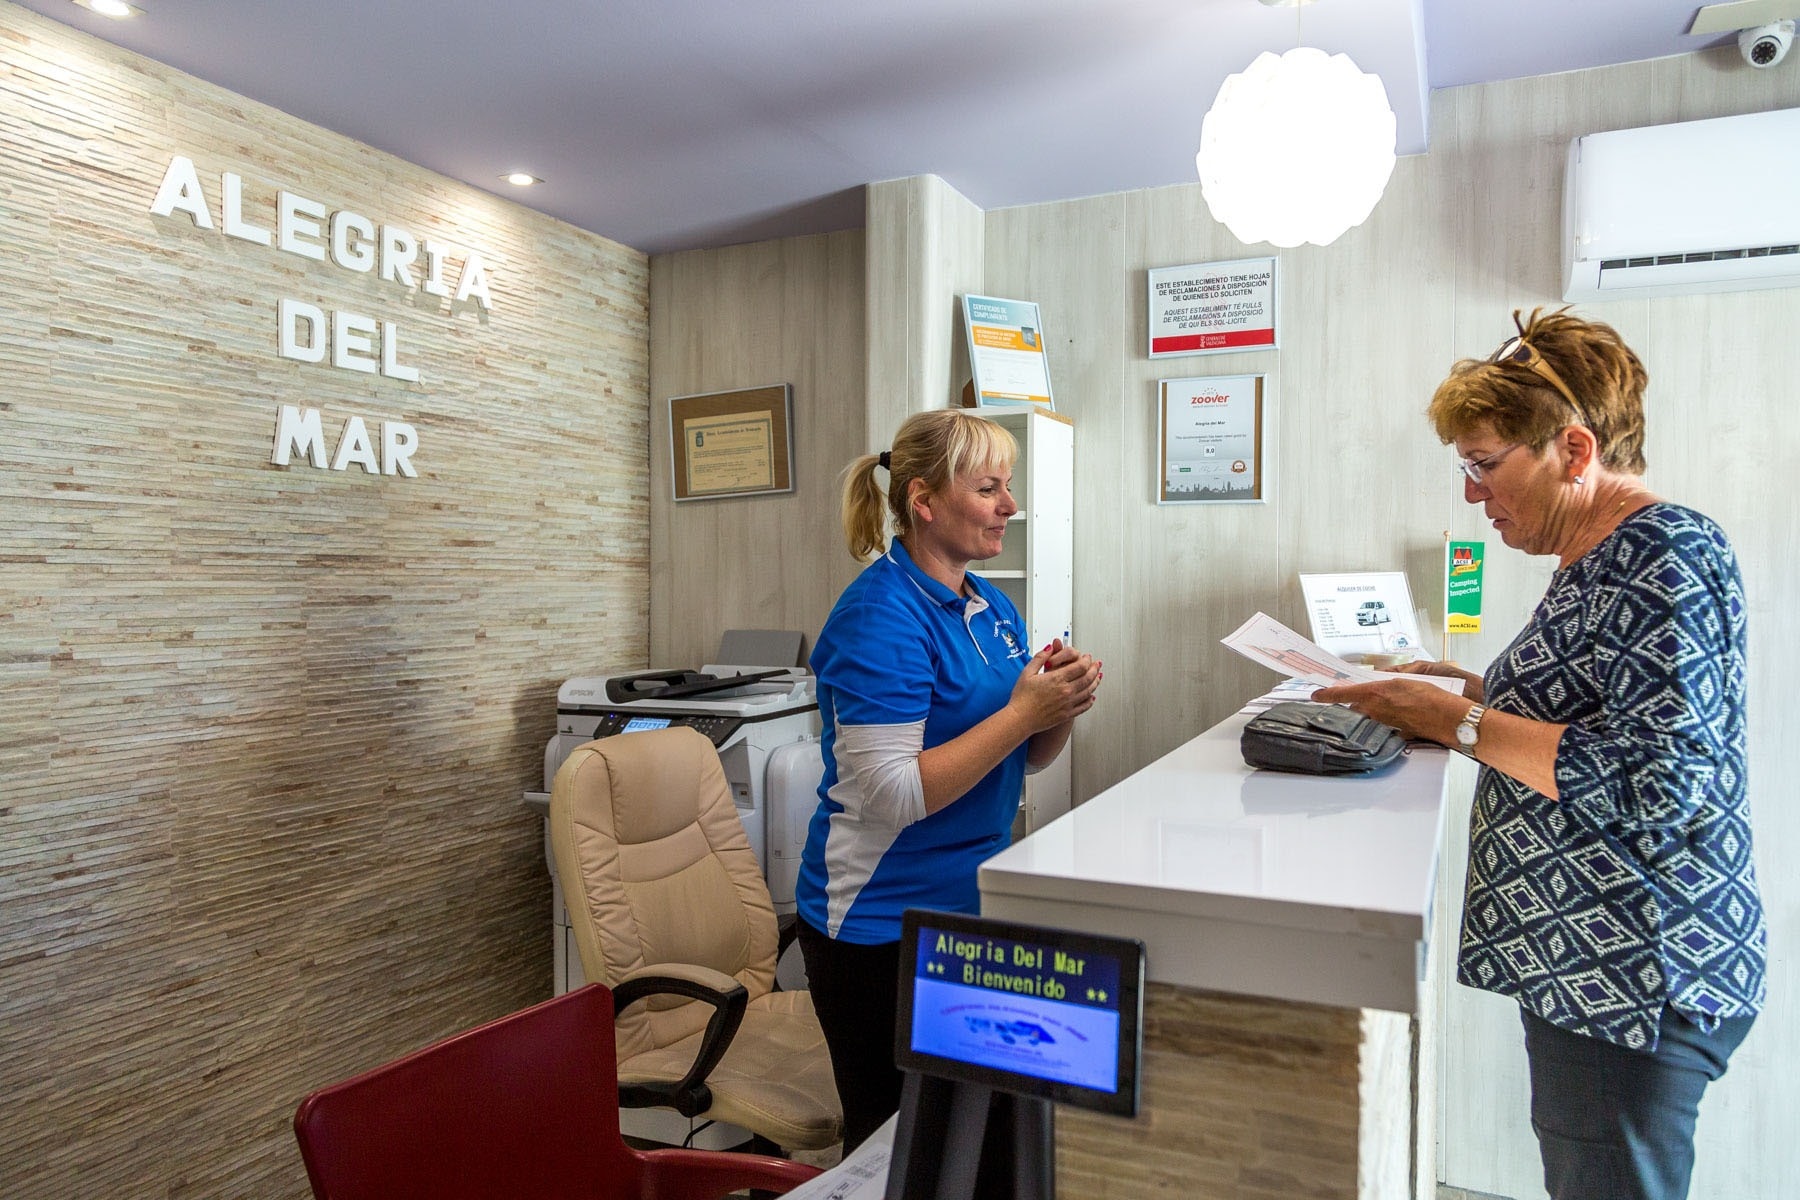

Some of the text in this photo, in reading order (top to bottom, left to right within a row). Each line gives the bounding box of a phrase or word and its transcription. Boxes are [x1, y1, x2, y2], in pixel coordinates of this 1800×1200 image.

[150, 155, 494, 310] ALEGRIA
[1172, 276, 1228, 287] ESTABLECIMIENTO
[1169, 285, 1220, 295] RECLAMACIONES
[1183, 292, 1209, 300] QUIENES
[1220, 289, 1252, 297] SOLICITEN
[1190, 305, 1232, 314] ESTABLIMENT
[1173, 313, 1221, 322] RECLAMACIONS
[277, 298, 419, 383] DEL
[1191, 394, 1230, 404] zoover
[271, 404, 419, 478] MAR
[1450, 579, 1478, 588] Camping
[1450, 586, 1480, 597] Inspected
[936, 933, 1086, 976] Alegria Del Mar
[963, 963, 1066, 1000] Bienvenido
